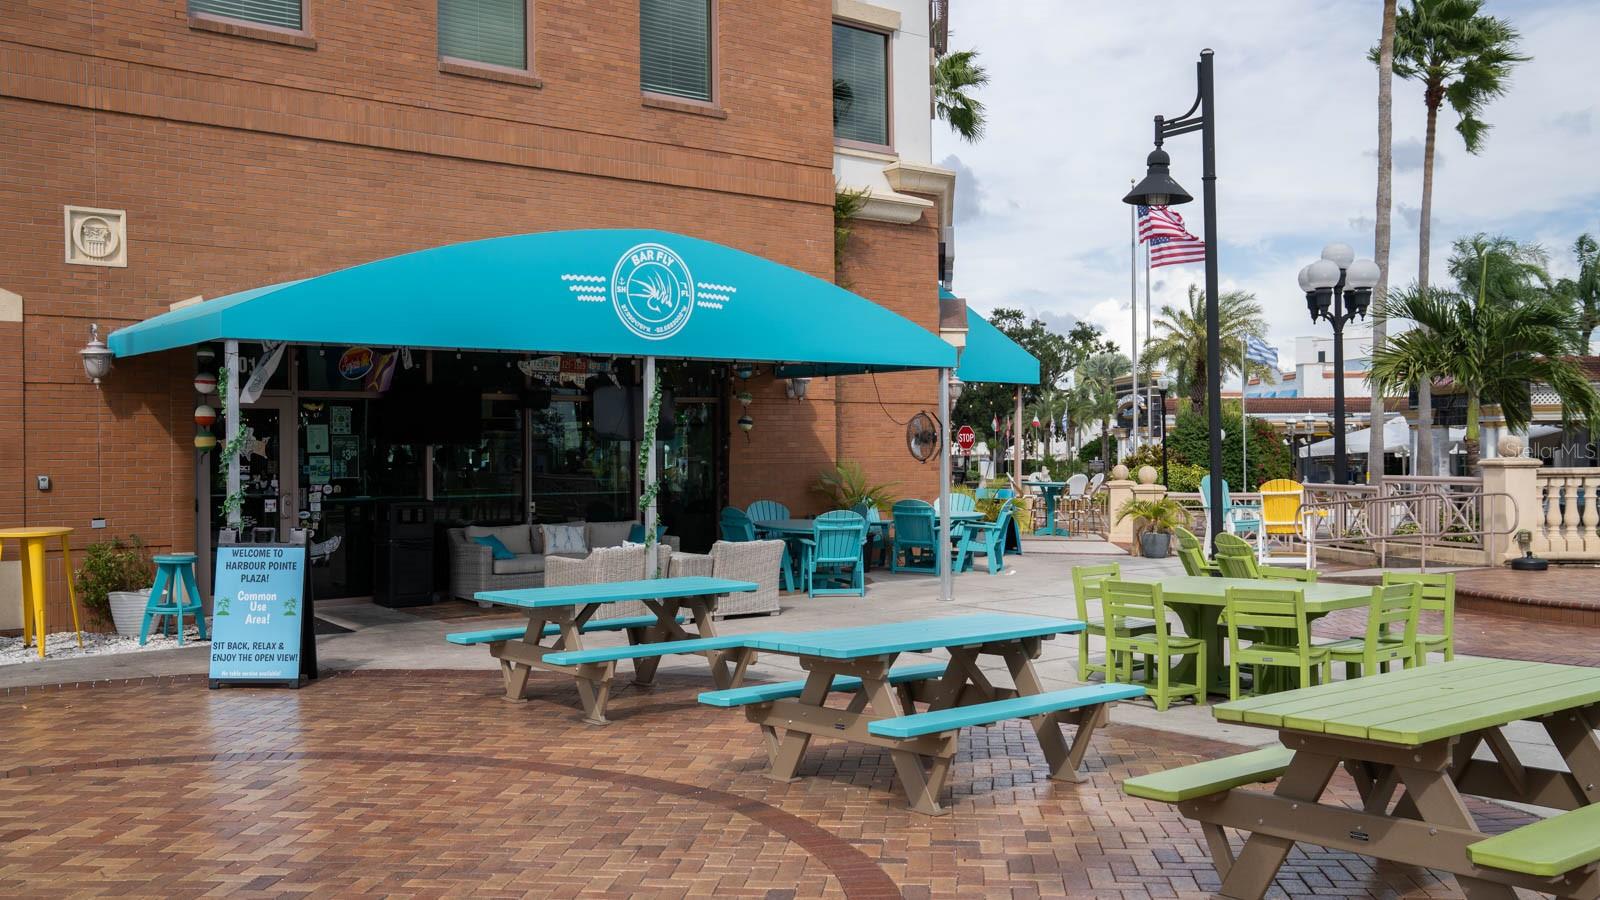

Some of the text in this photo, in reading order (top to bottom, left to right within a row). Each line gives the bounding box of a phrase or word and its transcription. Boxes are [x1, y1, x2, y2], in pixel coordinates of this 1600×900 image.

[631, 250, 674, 267] BAR FLY
[958, 434, 974, 442] STOP
[232, 549, 284, 558] WELCOME TO
[226, 562, 297, 570] HARBOUR POINTE
[240, 574, 270, 583] PLAZA!
[238, 591, 277, 601] Common
[250, 602, 266, 612] Use
[245, 614, 270, 625] Area!
[212, 642, 284, 651] SIT BACK, RELAX &
[212, 654, 298, 662] ENJOY THE OPEN VIEW!
